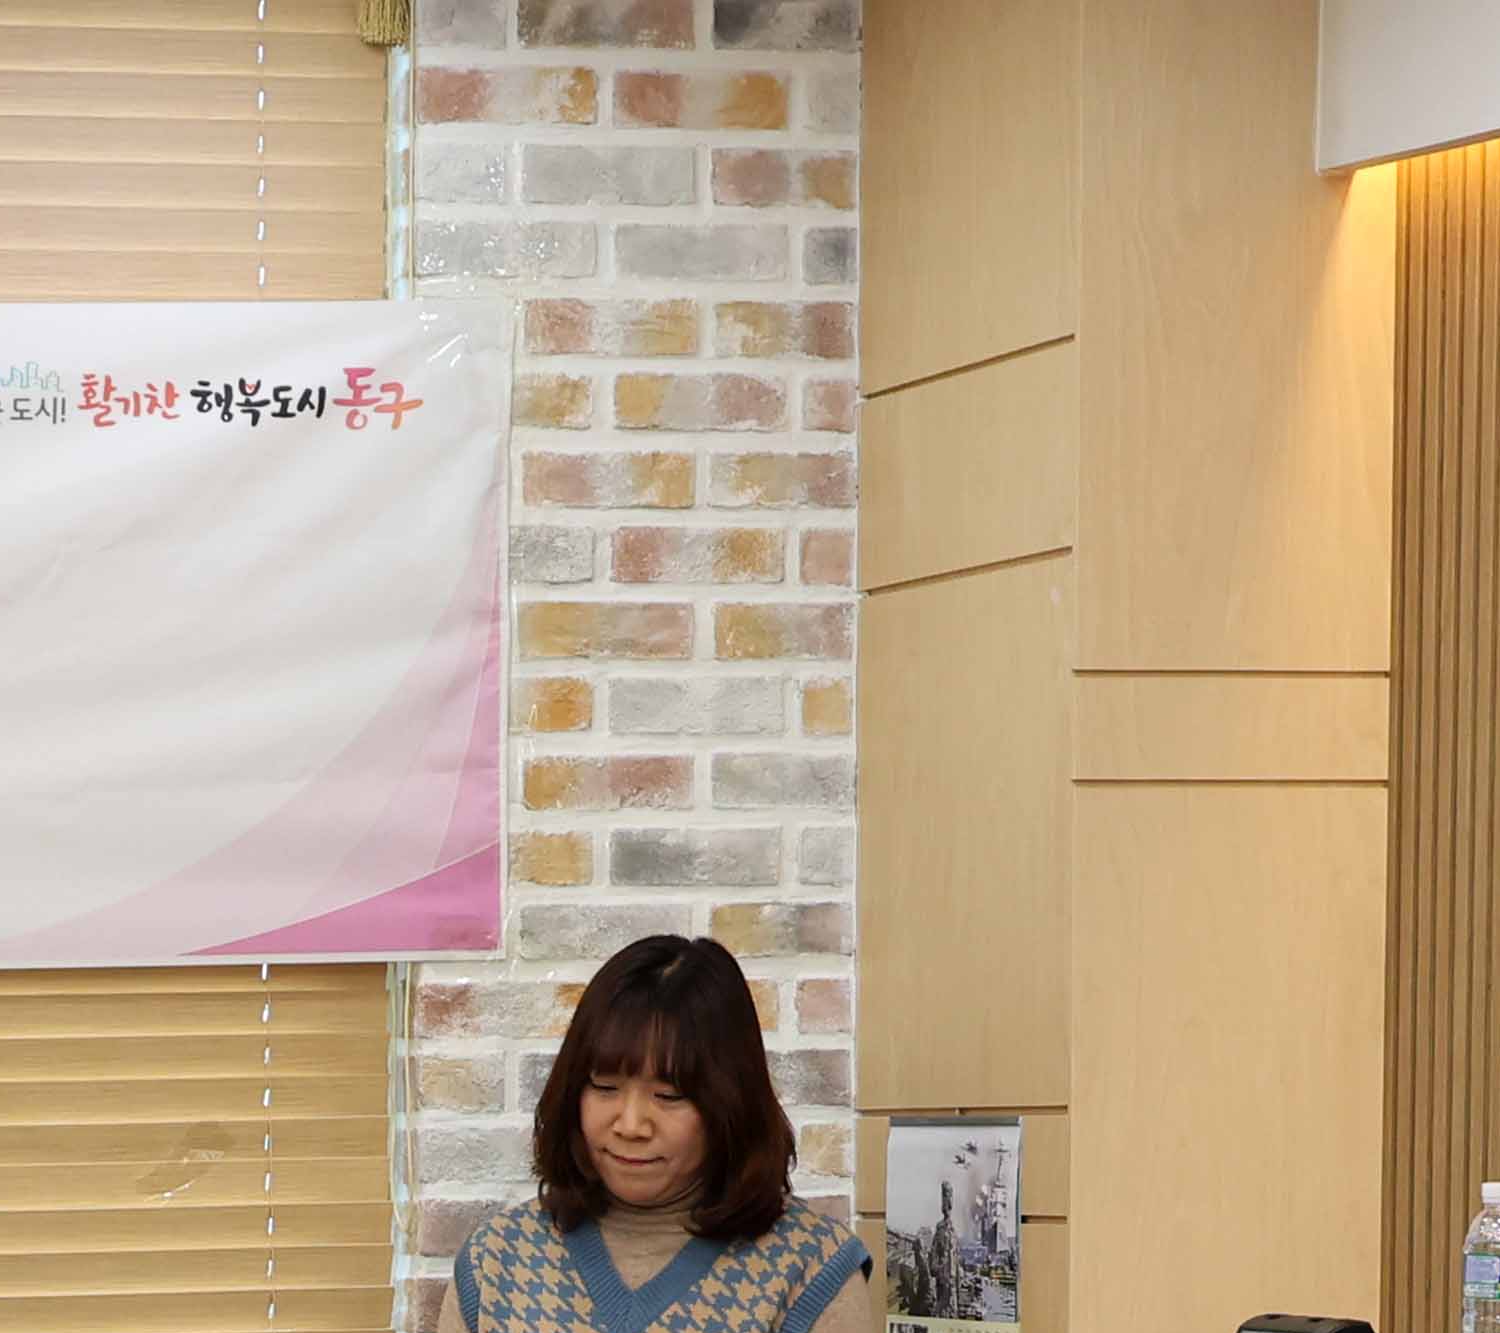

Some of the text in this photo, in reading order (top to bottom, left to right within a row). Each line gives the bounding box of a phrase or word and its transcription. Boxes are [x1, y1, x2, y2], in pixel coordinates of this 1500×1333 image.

[10, 397, 67, 425] 도시!
[78, 374, 180, 428] 활기찬
[189, 377, 328, 428] 행복도시
[332, 367, 425, 430] 동구
